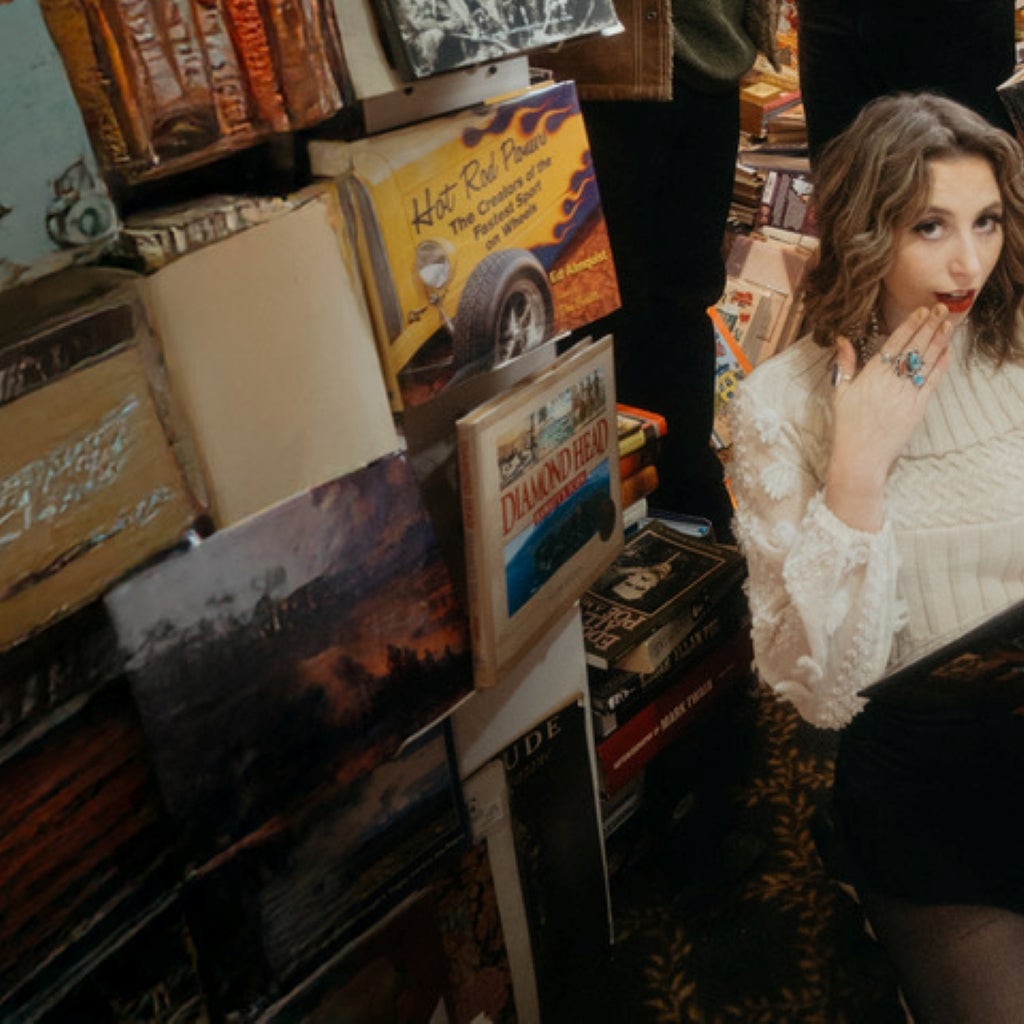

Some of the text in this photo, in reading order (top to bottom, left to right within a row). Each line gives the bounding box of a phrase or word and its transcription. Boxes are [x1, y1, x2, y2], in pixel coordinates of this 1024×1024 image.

[411, 182, 458, 235] Hot
[459, 151, 499, 200] Rod
[449, 212, 476, 235] The
[476, 176, 524, 216] Creators
[536, 156, 553, 174] the
[472, 179, 543, 241] Fastest Sport
[485, 203, 538, 251] on Wheels
[500, 447, 572, 537] DIAMOND
[572, 417, 609, 469] HEAD
[503, 713, 562, 771] UDE
